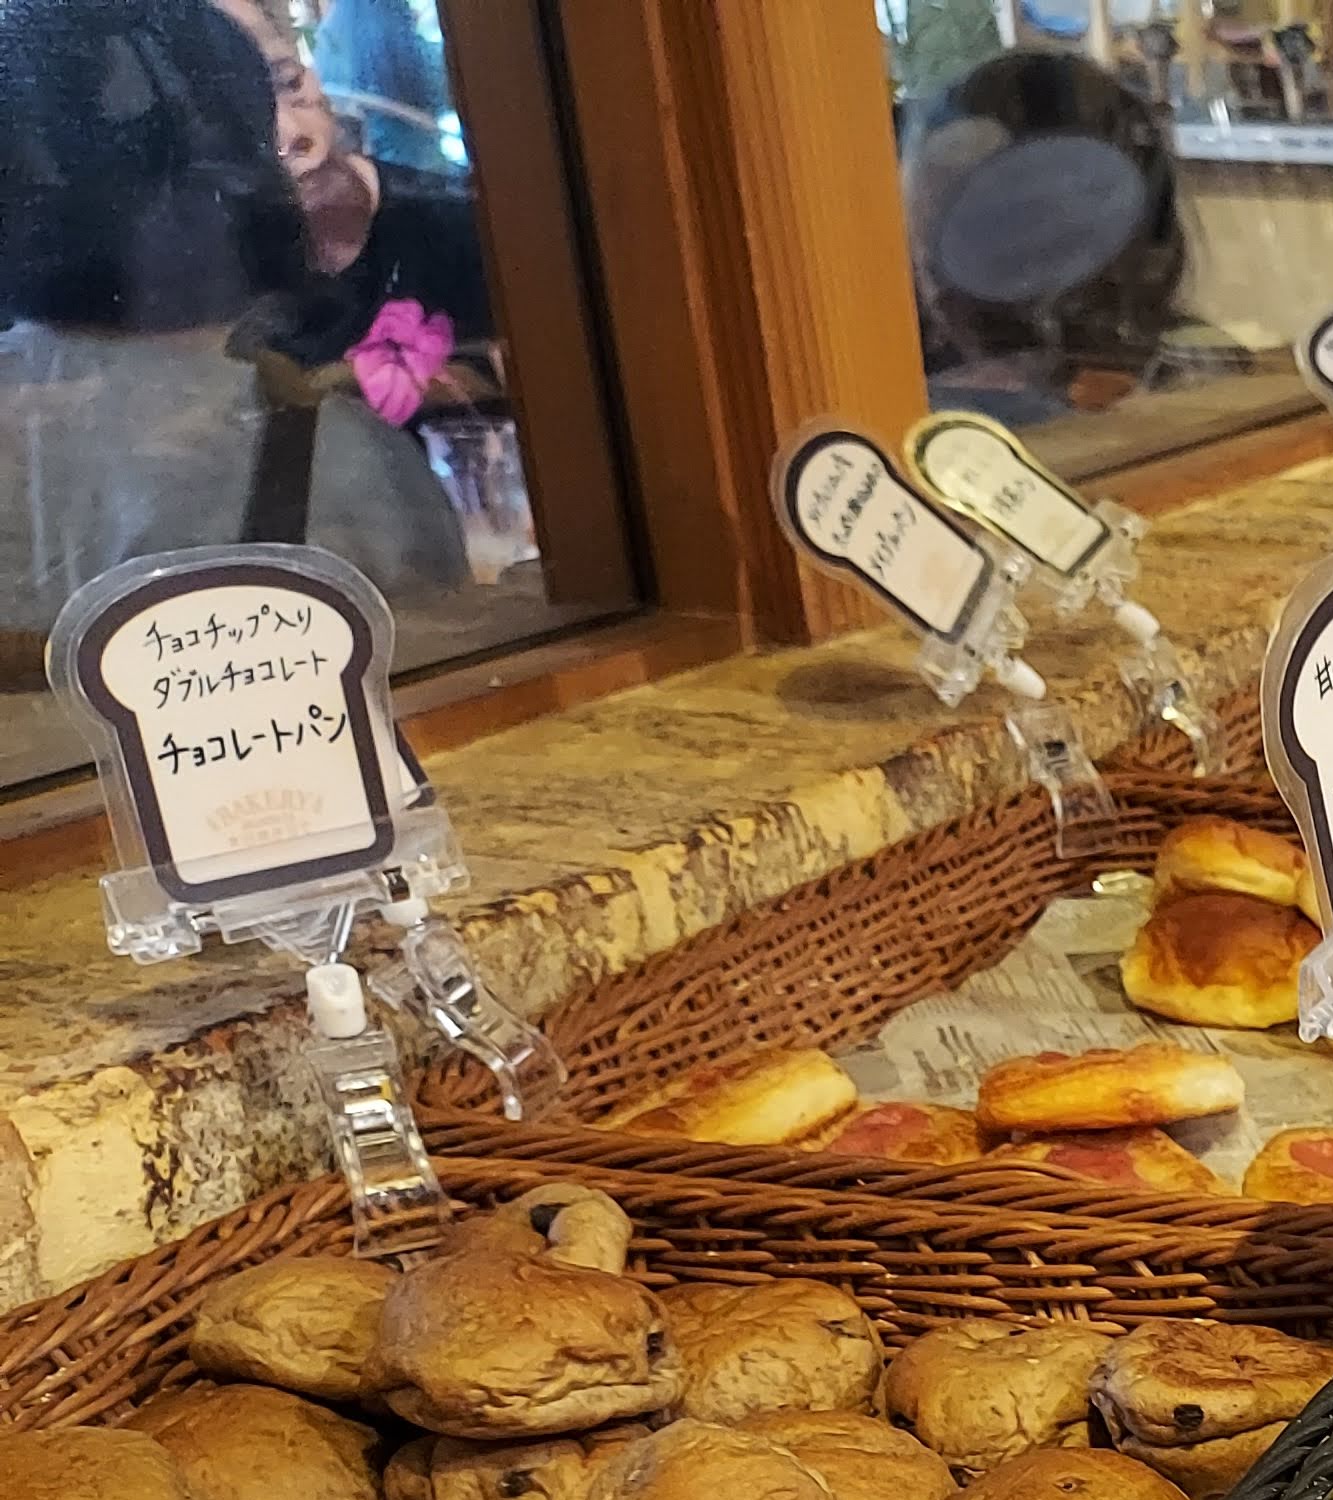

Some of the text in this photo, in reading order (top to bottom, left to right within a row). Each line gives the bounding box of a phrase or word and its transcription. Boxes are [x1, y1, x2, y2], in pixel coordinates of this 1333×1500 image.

[145, 604, 312, 660] チョコチップ入り
[153, 649, 328, 708] ダブルチョコレート
[157, 704, 346, 774] チョコレートパン
